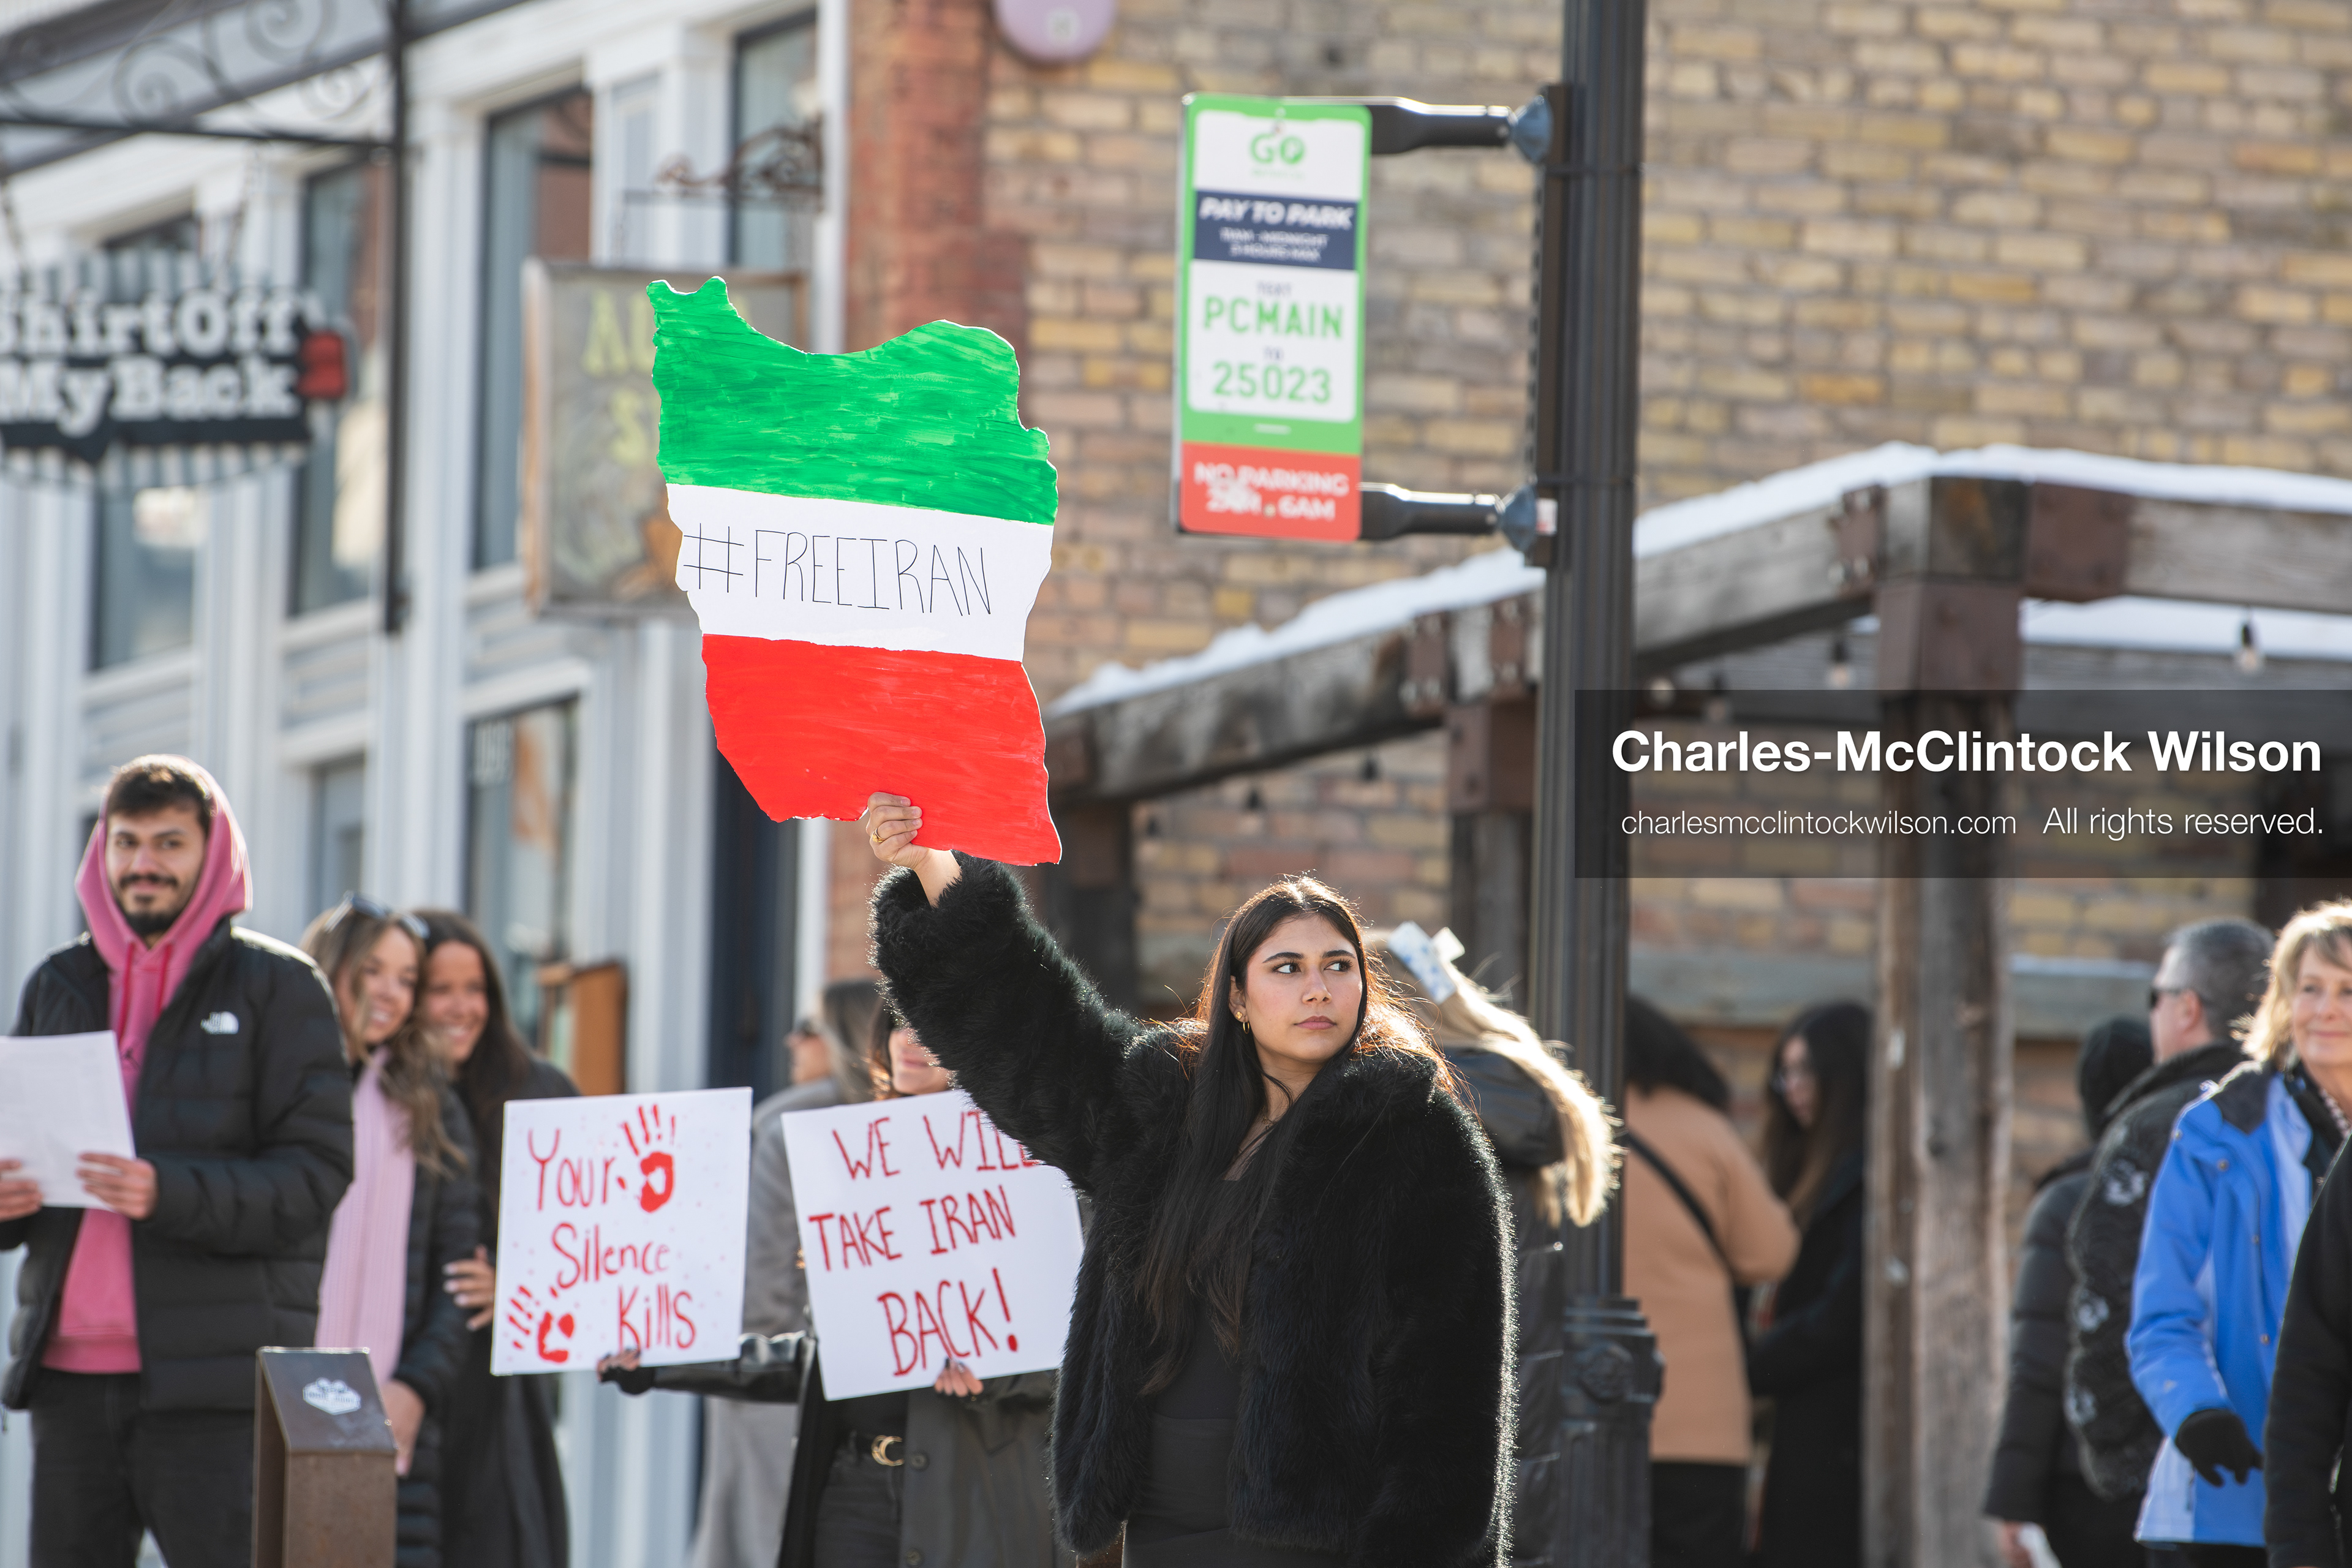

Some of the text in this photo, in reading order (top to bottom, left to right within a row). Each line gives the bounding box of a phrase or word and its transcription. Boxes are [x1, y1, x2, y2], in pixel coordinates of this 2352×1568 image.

[1250, 133, 1305, 165] GO
[1199, 197, 1354, 230] PAY TO PARK
[1204, 296, 1343, 339] PCMAIN
[1212, 361, 1331, 404] 25023
[1194, 461, 1350, 497] NO PARKING
[1278, 494, 1336, 521] 6AM
[528, 1129, 616, 1212] Your
[832, 1117, 900, 1180] WE
[808, 1185, 1016, 1272] TAKE IRAN
[552, 1223, 670, 1289] Silence
[618, 1283, 696, 1352] Kills
[876, 1267, 1019, 1378] BACK!
